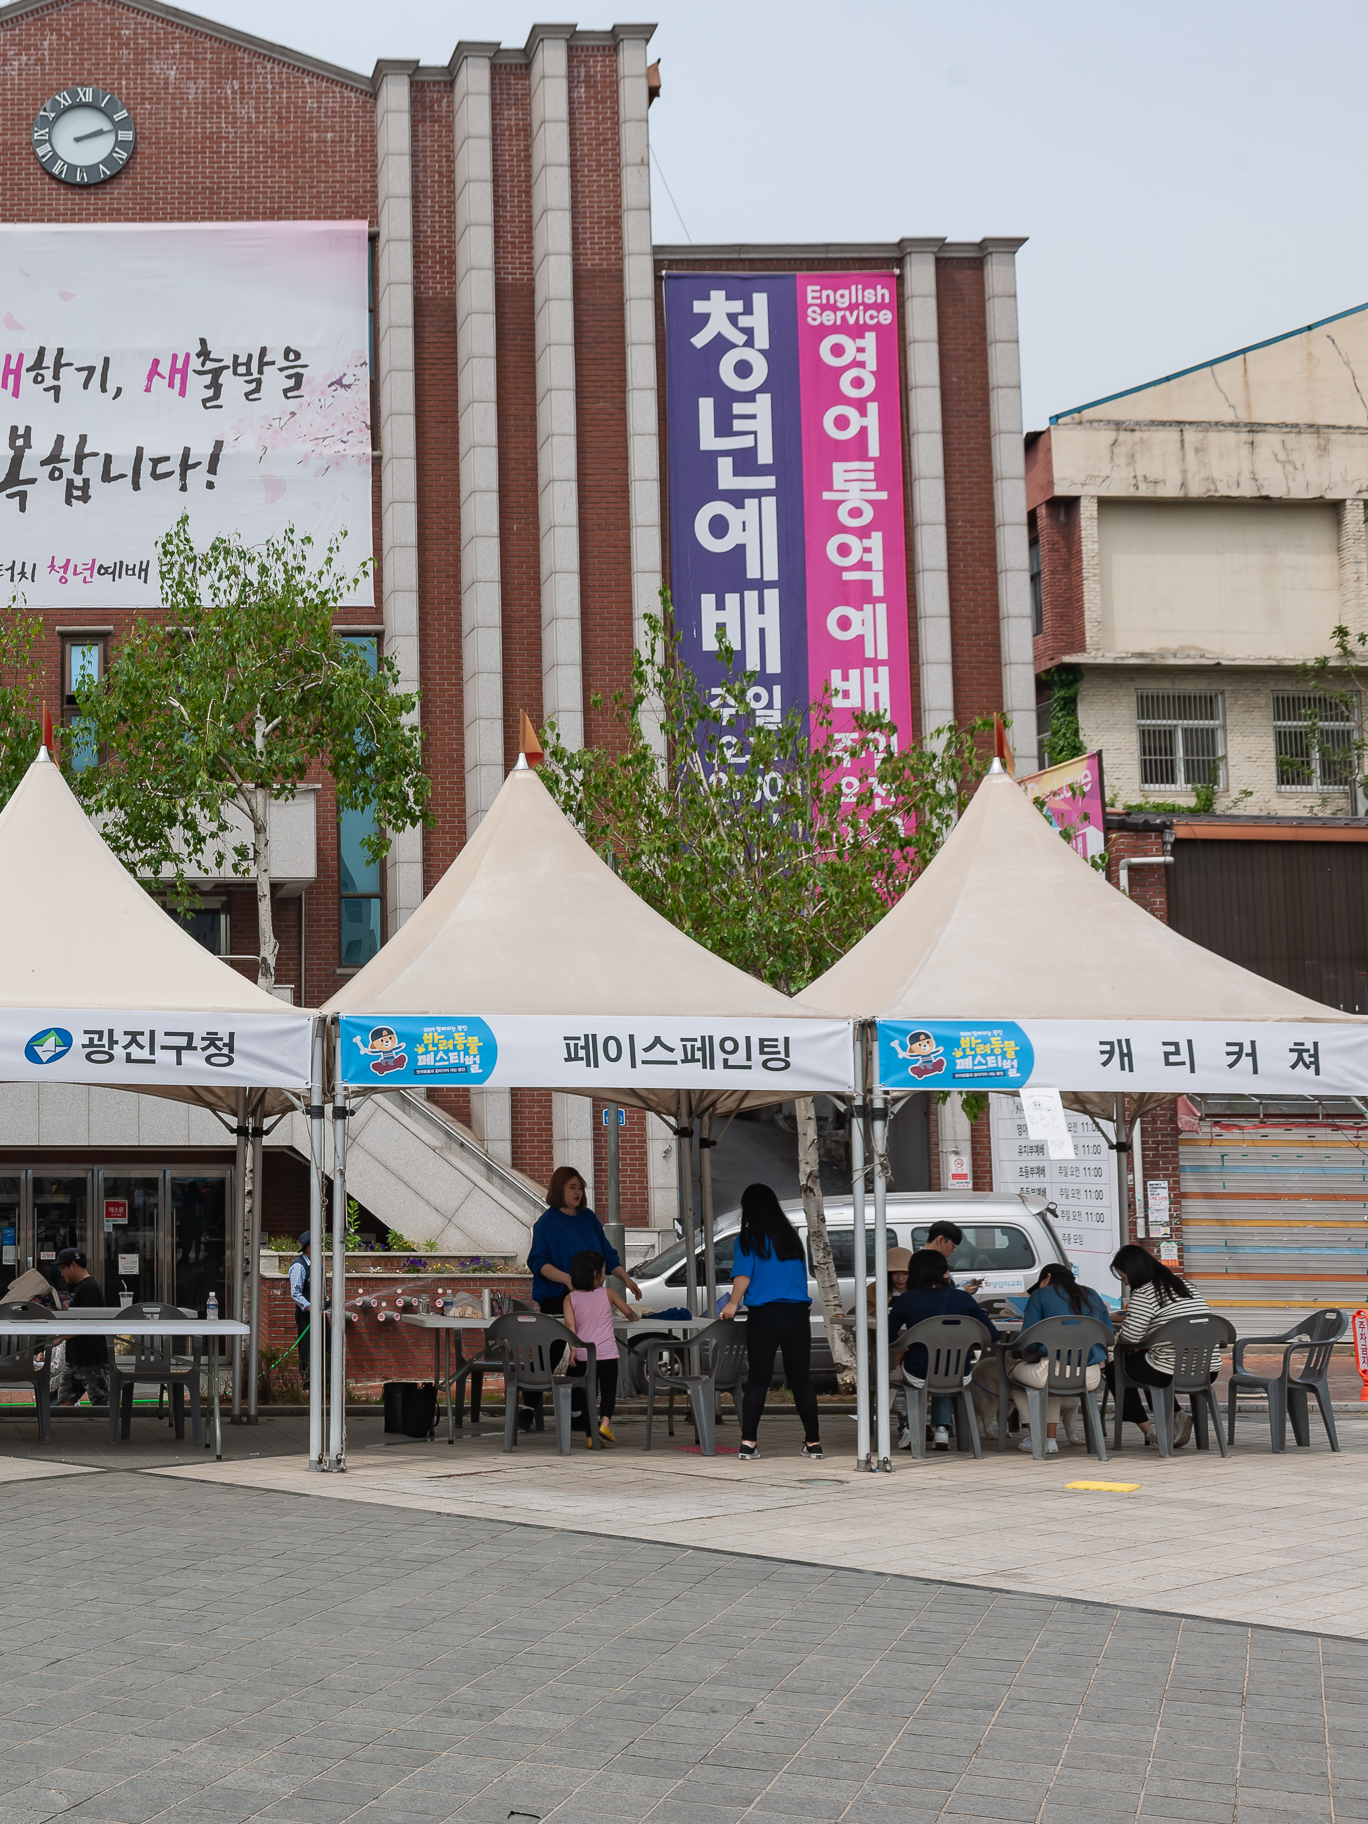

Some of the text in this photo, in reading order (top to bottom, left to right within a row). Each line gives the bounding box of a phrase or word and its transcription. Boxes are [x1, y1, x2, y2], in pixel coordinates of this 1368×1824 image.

[807, 286, 890, 305] English
[806, 306, 892, 326] Service
[144, 338, 309, 410] 새출발을
[690, 290, 782, 674] 청년예배
[819, 331, 892, 723] 영어통역예배
[47, 556, 150, 585] 청년예배
[81, 1028, 235, 1068] 광진구청
[422, 1032, 484, 1055] 반려동물
[563, 1033, 792, 1072] 페이스페인팅
[959, 1036, 1020, 1059] 반려동물
[417, 1050, 483, 1074] 페스티벌
[955, 1054, 1021, 1077] 페스티벌
[1082, 1144, 1102, 1155] 11:00
[1018, 1165, 1103, 1178] 초등부예배 주일 오전 11:00
[1059, 1188, 1069, 1199] 주일
[1071, 1188, 1081, 1199] 오전
[1084, 1189, 1104, 1200] 11:00
[1060, 1210, 1105, 1223] 주일 오전 11:00
